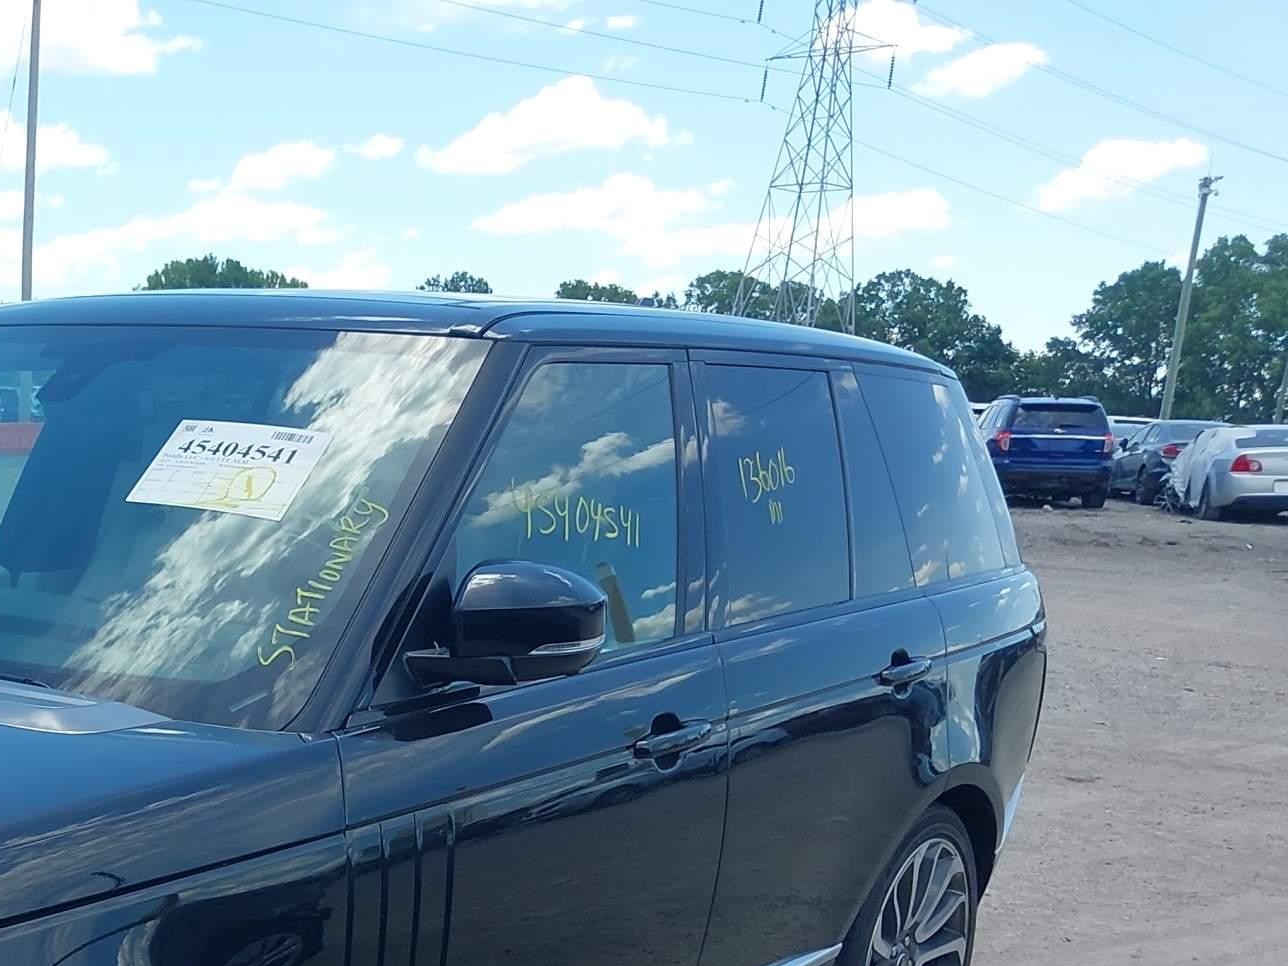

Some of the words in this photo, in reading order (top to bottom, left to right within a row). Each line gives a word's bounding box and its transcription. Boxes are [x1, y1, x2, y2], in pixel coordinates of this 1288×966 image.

[177, 438, 299, 465] 45404541
[738, 446, 795, 504] 136016
[511, 477, 640, 548] 45404541
[257, 498, 389, 671] STATIONARY
